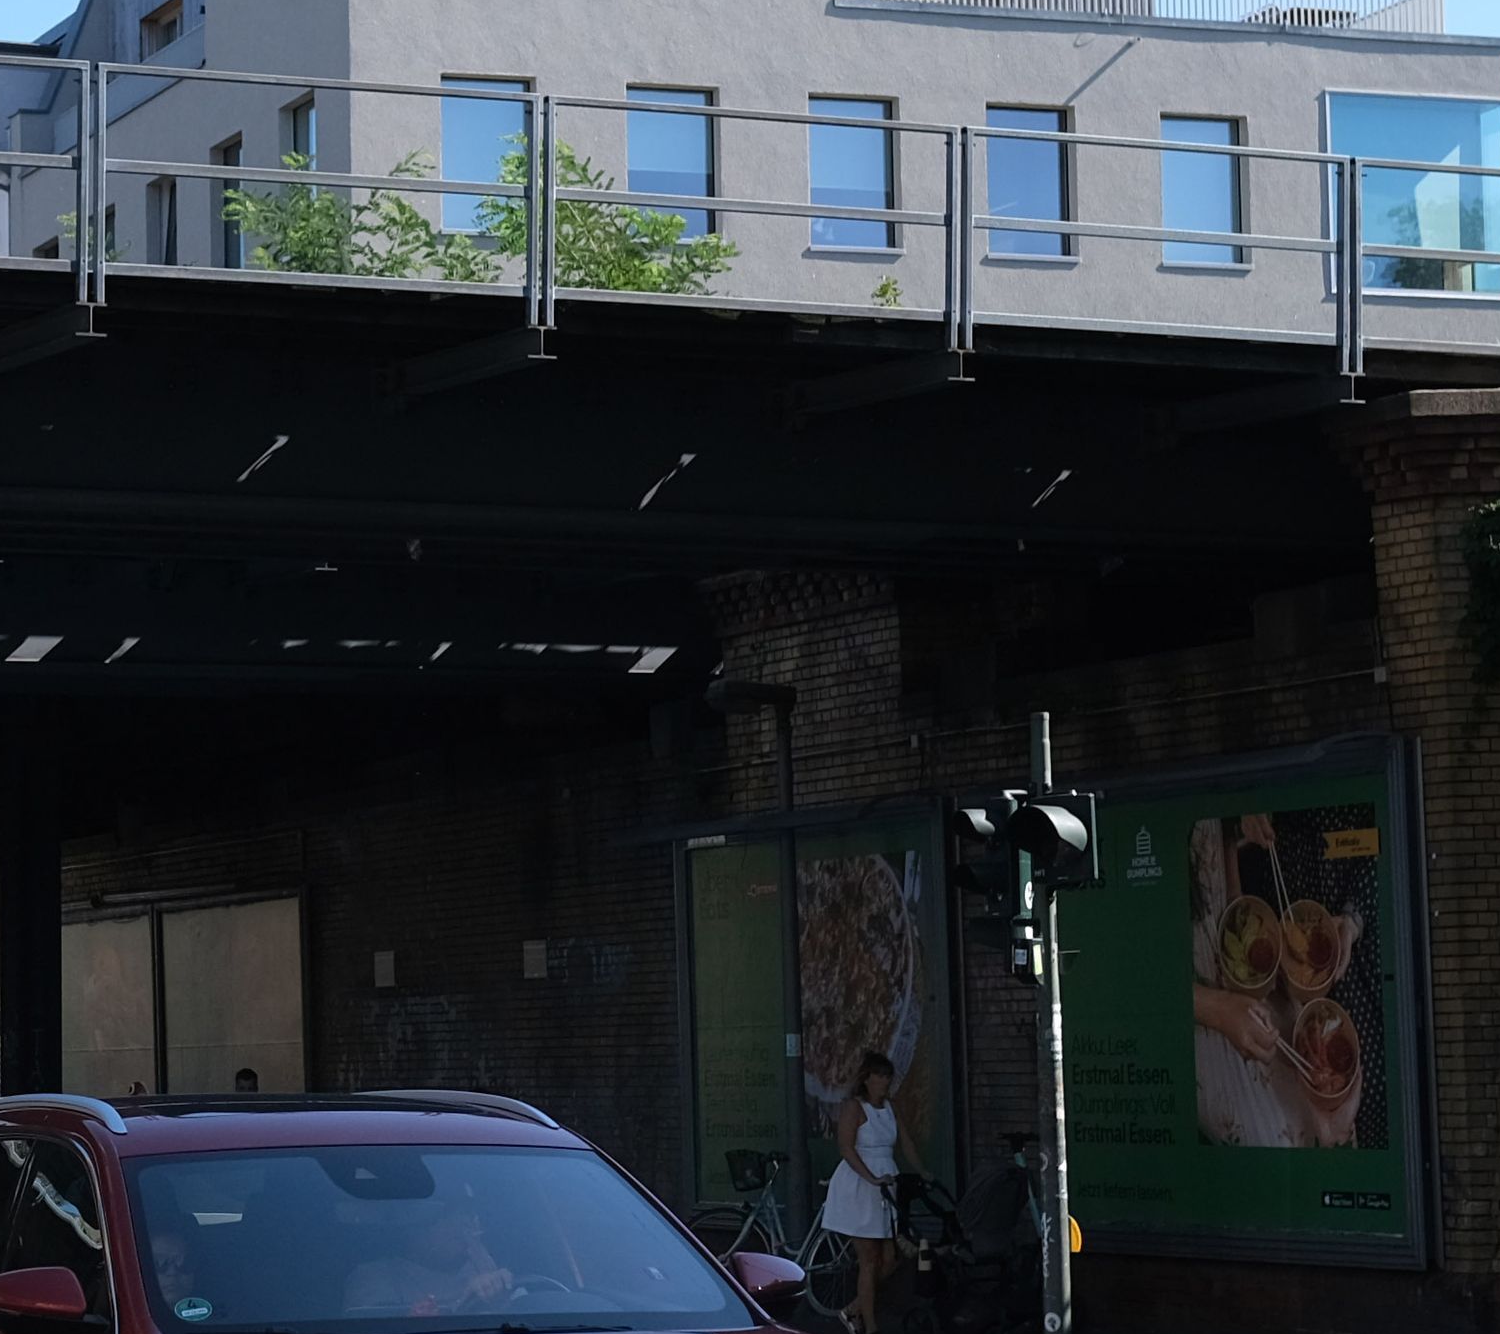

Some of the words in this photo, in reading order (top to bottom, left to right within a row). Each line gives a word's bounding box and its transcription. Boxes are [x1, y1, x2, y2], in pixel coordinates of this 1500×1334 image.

[1072, 1064, 1124, 1085] Erstmal
[1127, 1063, 1174, 1085] Essen.
[1074, 1122, 1126, 1144] Erstmal
[1129, 1122, 1176, 1145] Essen.
